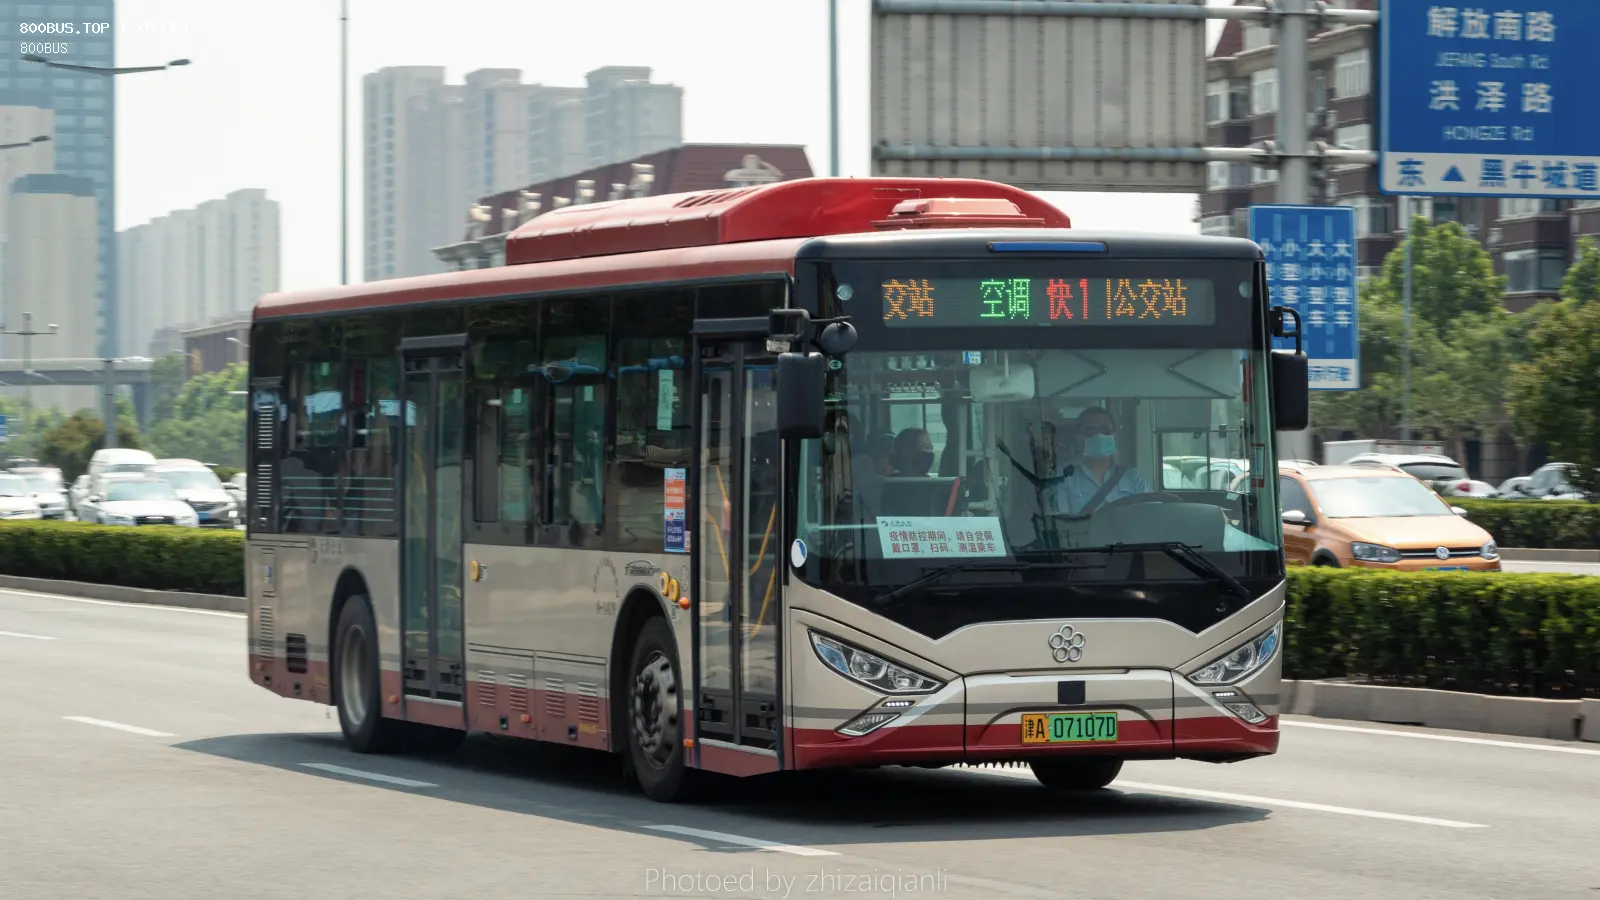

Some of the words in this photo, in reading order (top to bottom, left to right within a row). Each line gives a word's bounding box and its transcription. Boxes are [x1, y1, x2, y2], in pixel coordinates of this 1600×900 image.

[1427, 6, 1557, 41] 解放南路
[1428, 80, 1554, 113] 洪泽路
[1396, 158, 1426, 187] 东
[1478, 158, 1599, 191] 黑牛城道
[882, 279, 935, 320] 交站
[980, 279, 1030, 319] 空调
[1046, 279, 1088, 319] 快1
[1106, 279, 1188, 319] 公交站
